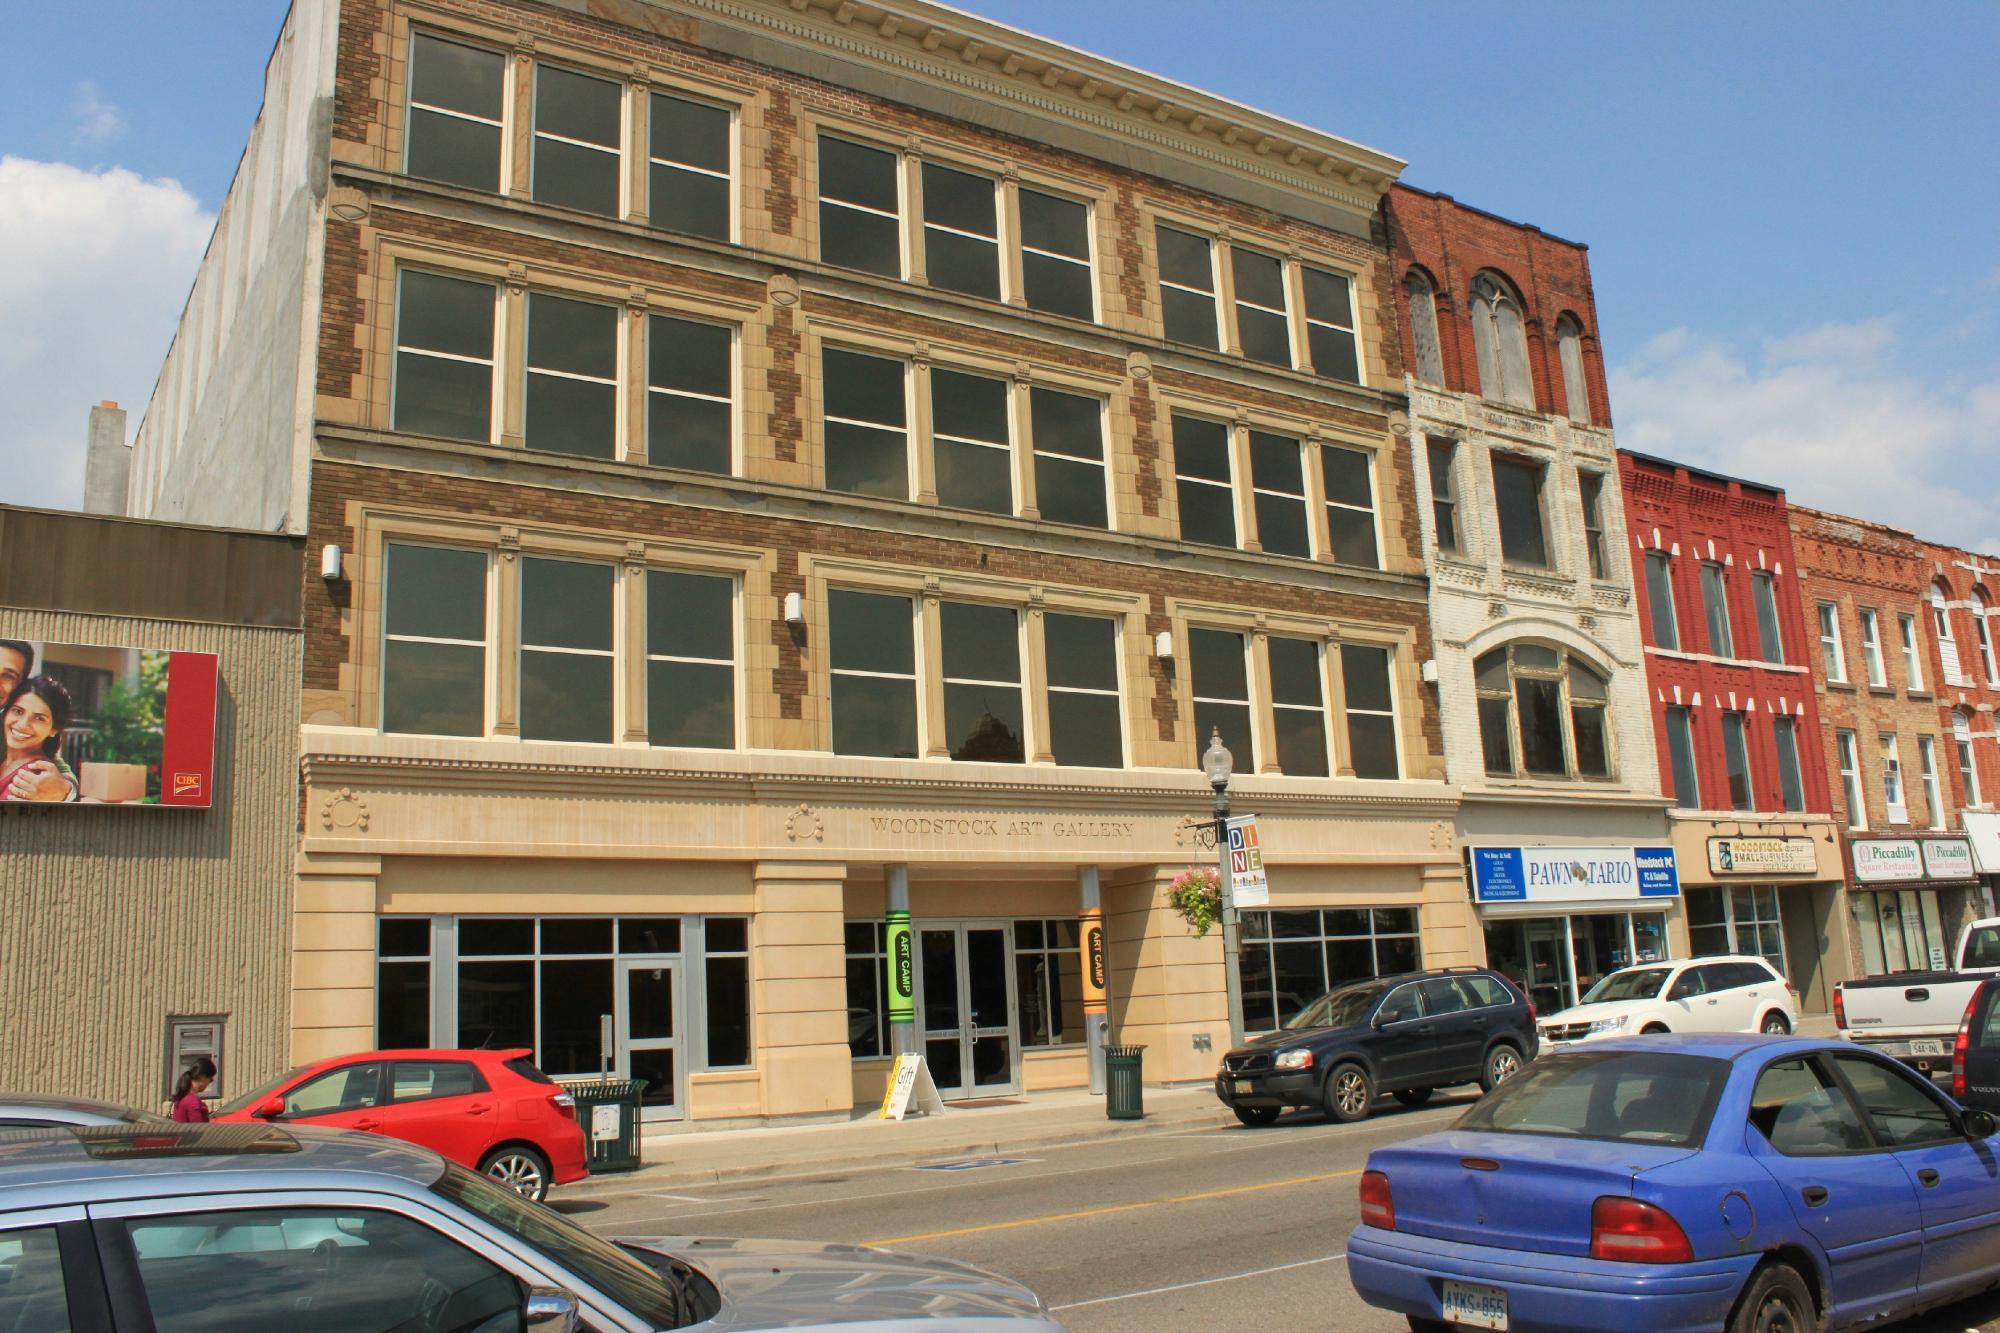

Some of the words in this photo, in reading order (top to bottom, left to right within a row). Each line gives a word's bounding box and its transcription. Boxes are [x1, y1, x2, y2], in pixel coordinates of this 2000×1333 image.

[176, 776, 199, 784] CIBC
[871, 817, 998, 836] WOODSTOCK
[1007, 819, 1043, 837] ART
[1053, 822, 1135, 838] GALLERY
[1733, 842, 1783, 852] WOODSTOCK
[1872, 846, 1915, 861] Piccadilly
[1936, 845, 1967, 861] Piccadilly
[1636, 857, 1664, 868] Woodstock
[1664, 856, 1673, 868] PC
[1530, 862, 1573, 885] PAWN
[1587, 861, 1632, 883] TARIO
[901, 936, 910, 958] ART
[1093, 932, 1102, 953] ART
[902, 960, 911, 992] CAMP
[1095, 954, 1104, 985] CAMP
[897, 1066, 914, 1084] Gift
